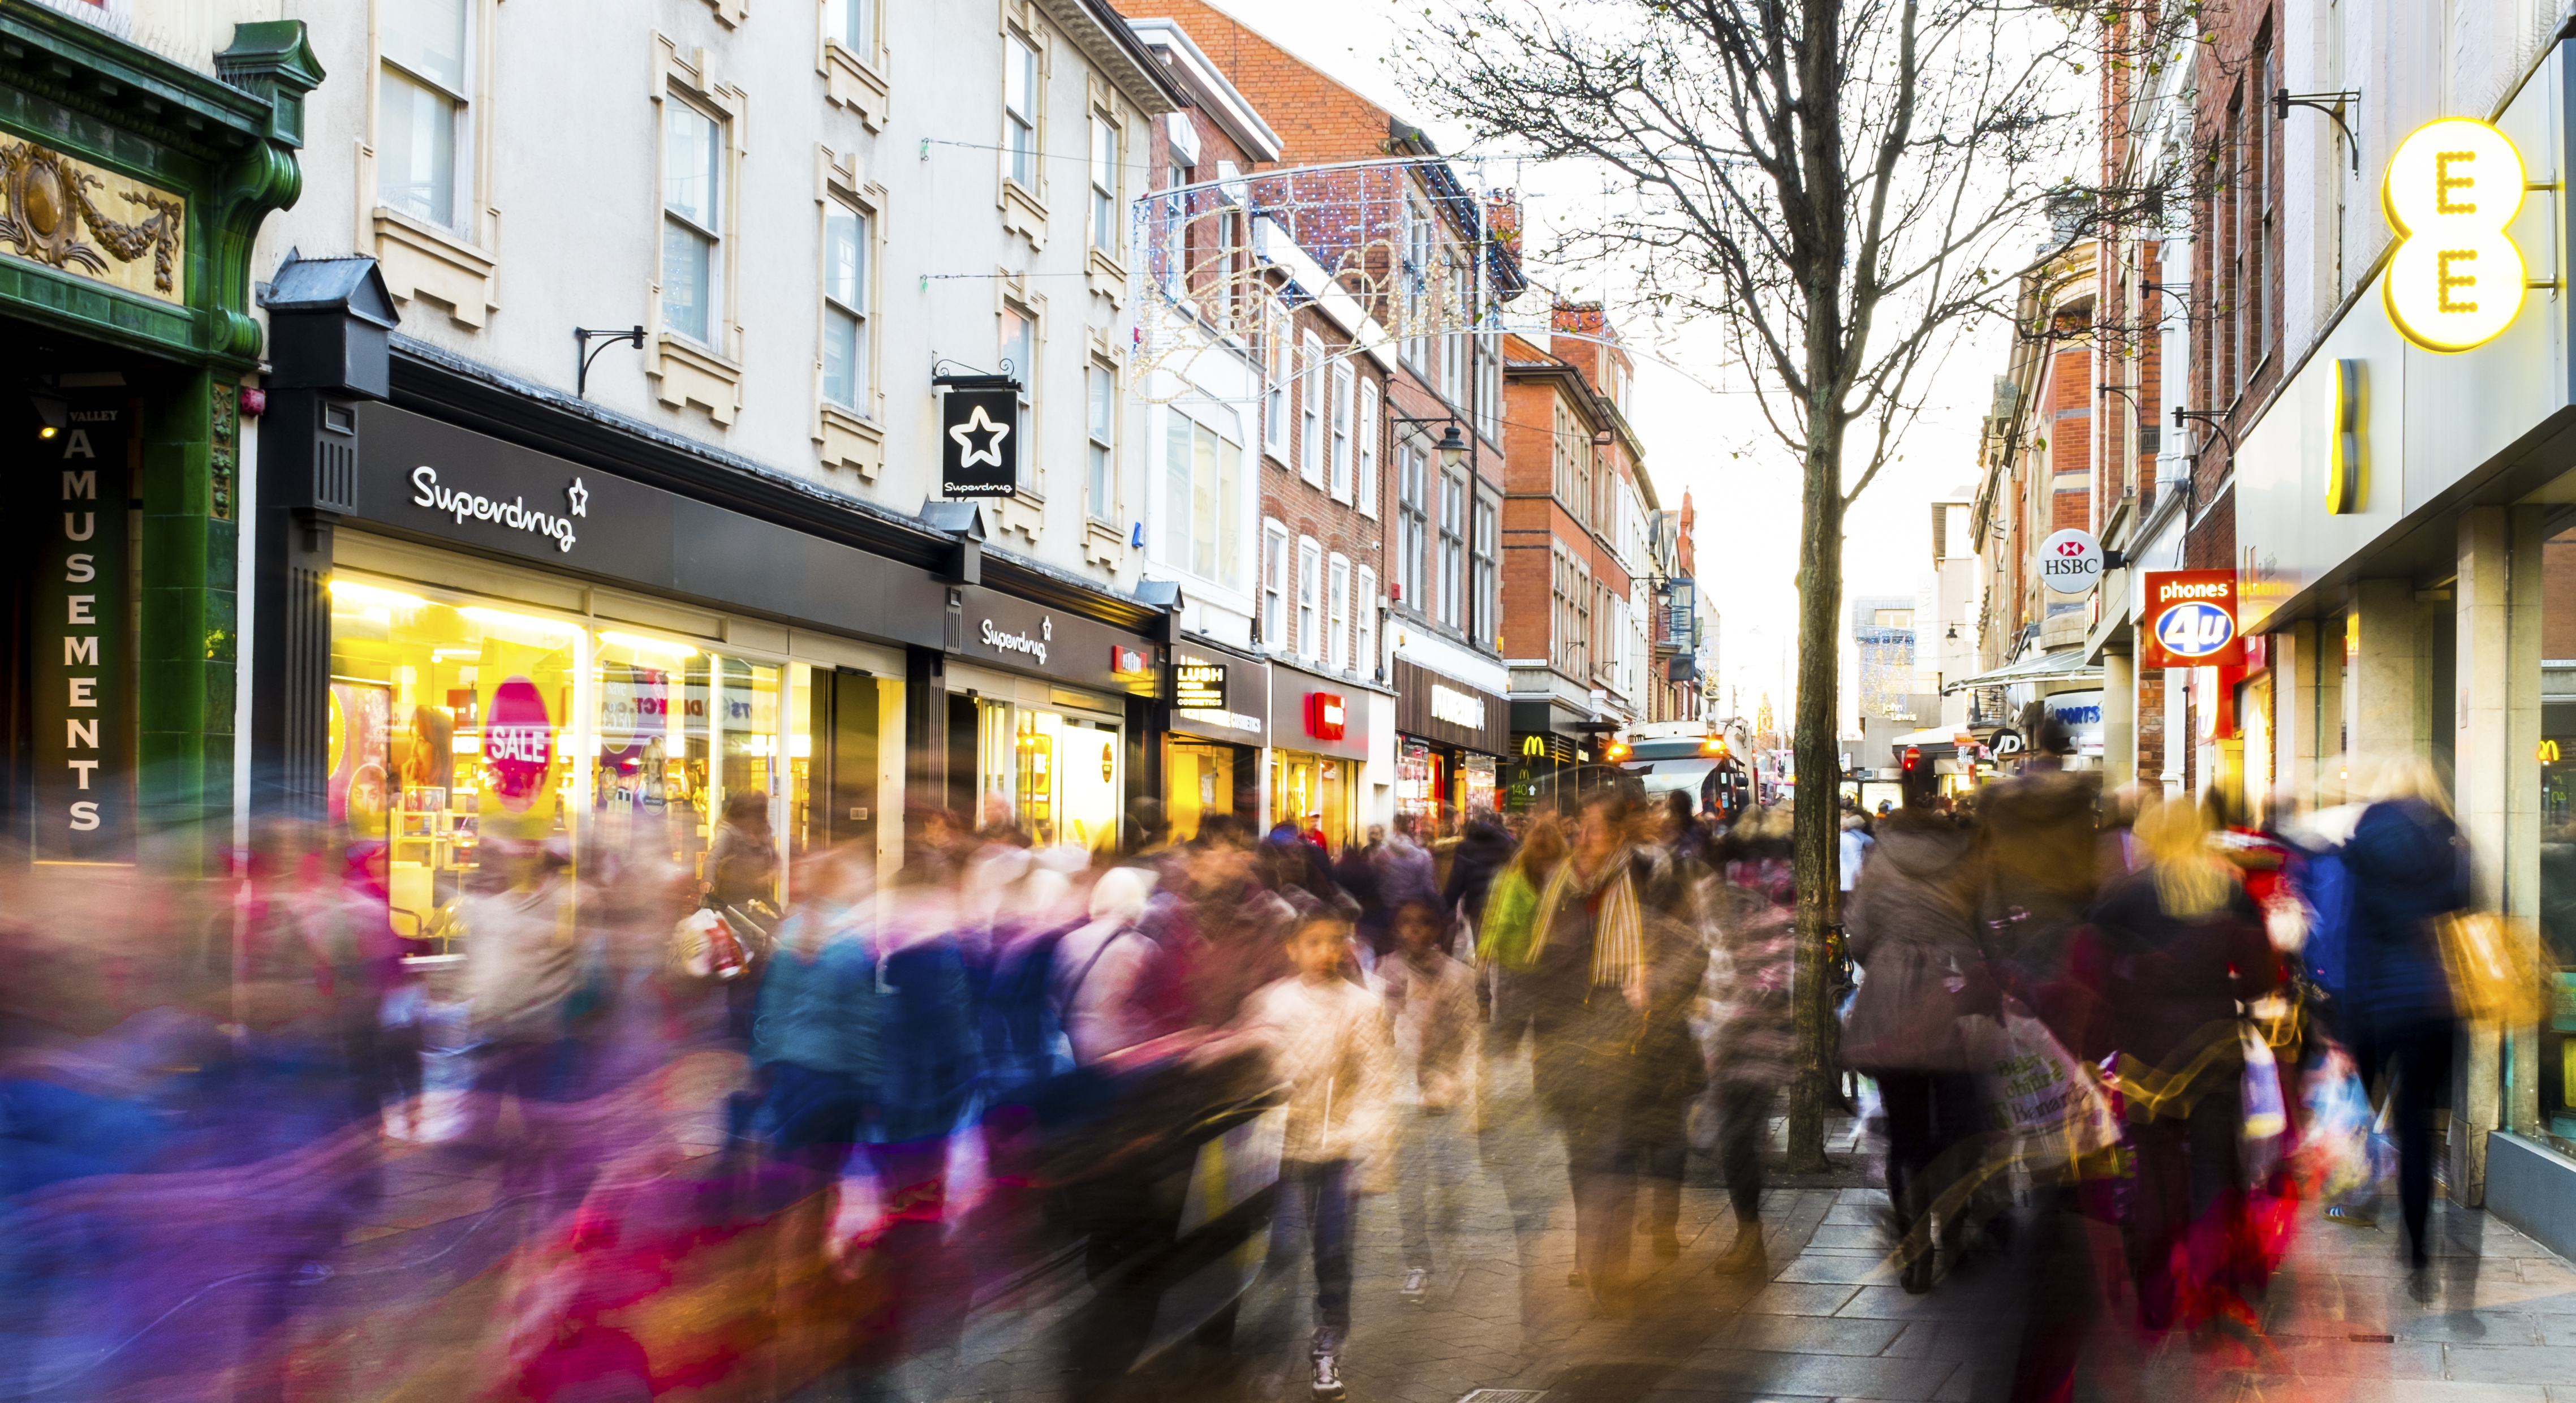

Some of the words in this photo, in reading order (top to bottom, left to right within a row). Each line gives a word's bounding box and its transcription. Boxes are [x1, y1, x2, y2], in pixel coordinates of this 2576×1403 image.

[69, 410, 118, 422] VALLEY
[944, 481, 1013, 494] Superdrug
[412, 466, 576, 553] Superdrug
[2044, 558, 2098, 575] HSBC
[2160, 581, 2228, 602] phones
[1913, 582, 1932, 622] Lewis
[62, 429, 101, 832] AMUSEMENTS
[2164, 606, 2227, 653] 4u
[982, 619, 1047, 665] Superdrug
[1916, 625, 1935, 660] John
[1177, 667, 1223, 681] LUSH
[1882, 703, 1903, 715] John
[1891, 712, 1917, 721] Lewis
[2055, 705, 2100, 725] SPORTS
[491, 725, 545, 763] SALE
[1992, 735, 2021, 754] JD
[1511, 784, 1527, 795] 140
